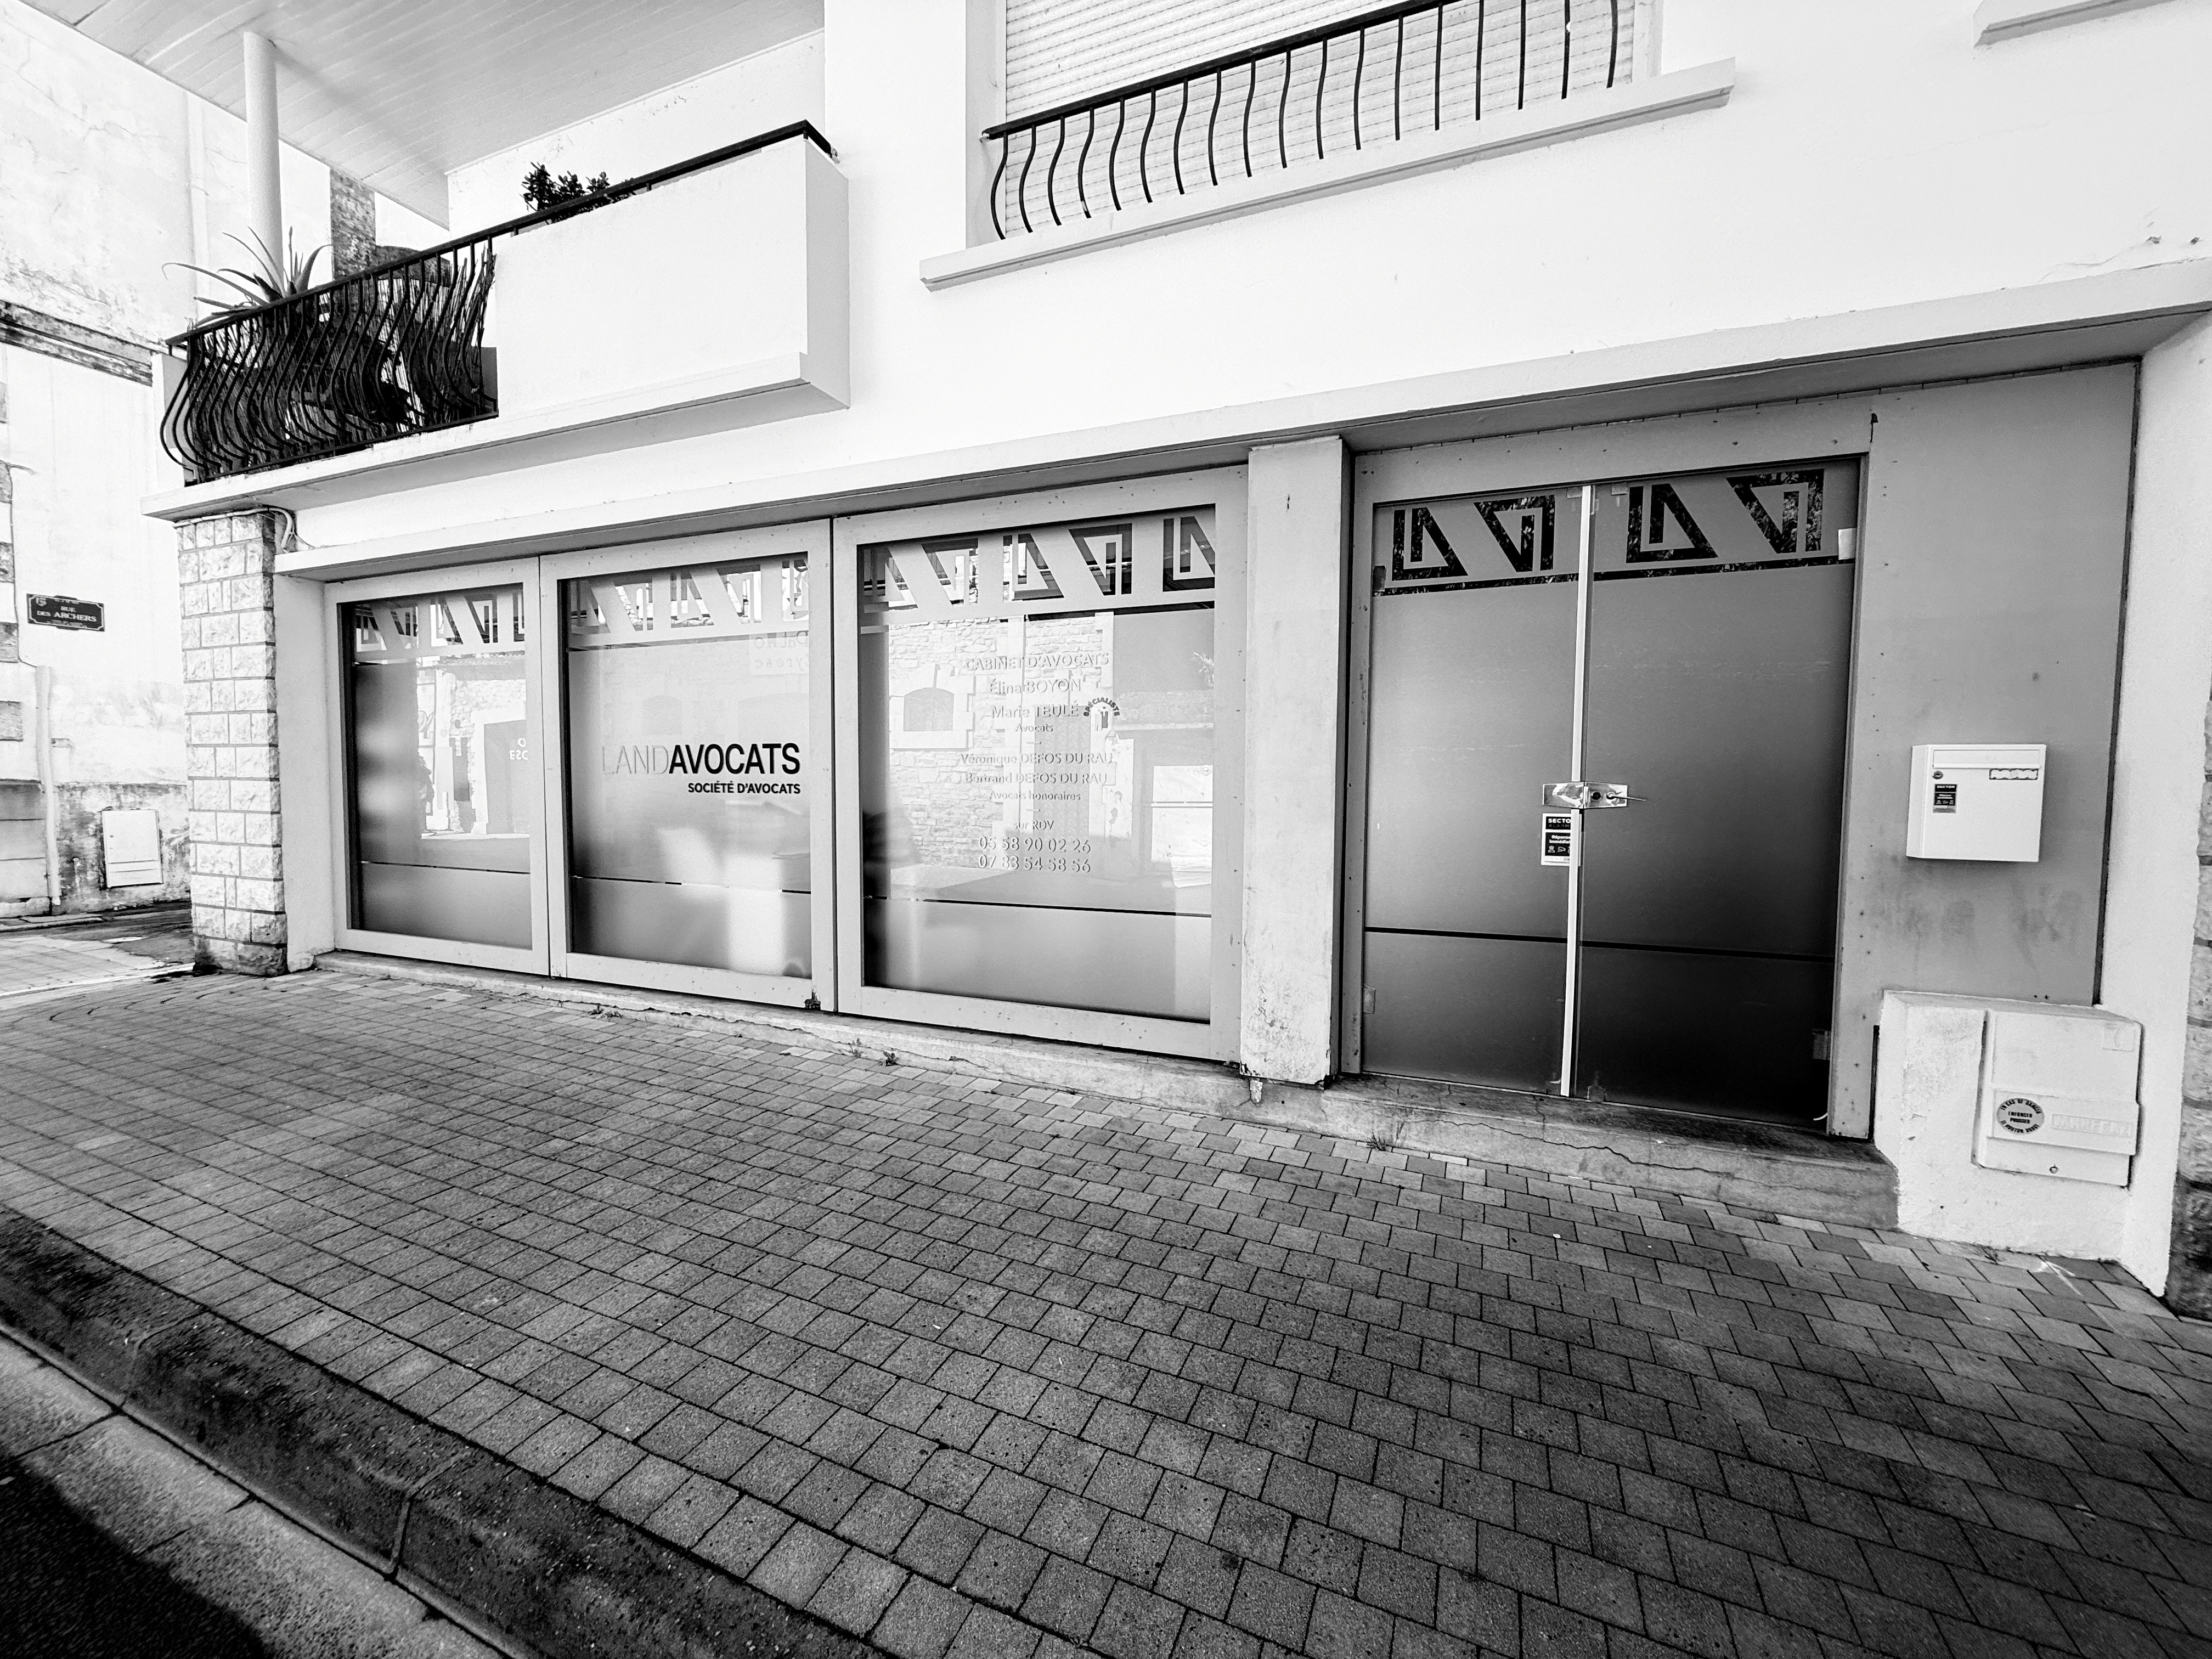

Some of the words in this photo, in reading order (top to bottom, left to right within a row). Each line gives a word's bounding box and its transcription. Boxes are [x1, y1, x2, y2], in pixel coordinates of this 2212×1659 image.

[54, 612, 97, 622] ARCHERS
[967, 657, 1022, 671] CABINET
[1026, 652, 1109, 668] D'AVOCATS
[990, 678, 1022, 695] Élina
[1025, 678, 1081, 693] BOYON
[992, 705, 1030, 719] Marie
[1035, 700, 1079, 718] TEULÉ
[1015, 723, 1054, 732] Avocats
[960, 753, 1017, 767] Véronique
[1020, 752, 1062, 764] DEFOS
[1065, 753, 1083, 764] DU
[1087, 752, 1113, 764] RAU
[966, 772, 1013, 784] Bertrand
[1017, 772, 1057, 784] DEFOS
[1060, 772, 1078, 784] DU
[1082, 772, 1107, 784] RAU
[688, 780, 734, 793] SOCIÉTÉ
[737, 782, 800, 794] D'AVOCATS
[990, 790, 1026, 801] Avocats
[1029, 790, 1081, 801] honoraires
[1032, 820, 1054, 830] RDV
[979, 836, 996, 849] 05
[1002, 837, 1019, 850] 58
[1025, 837, 1043, 851] 90
[1048, 838, 1066, 852] 02
[1072, 839, 1091, 853] 26
[979, 854, 996, 868] 07
[1002, 855, 1019, 870] 83
[1024, 856, 1042, 870] 54
[1048, 857, 1066, 871] 58
[1072, 859, 1091, 872] 56
